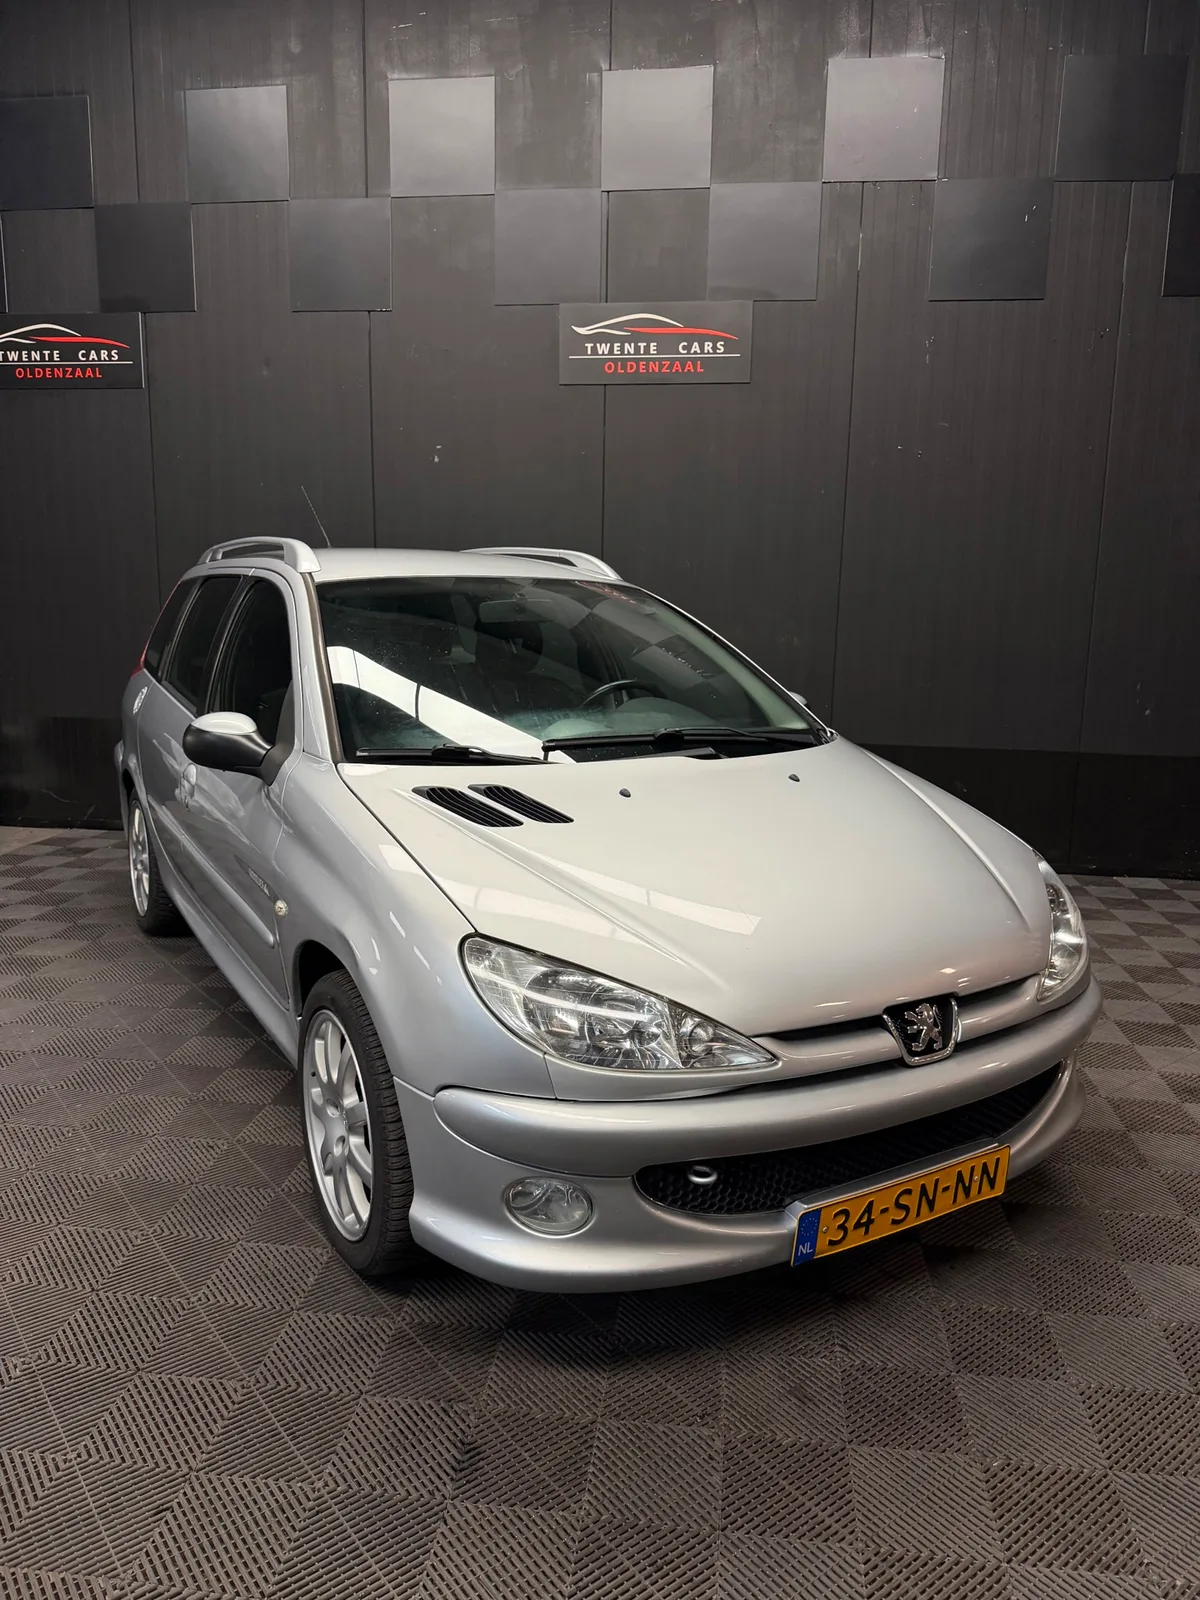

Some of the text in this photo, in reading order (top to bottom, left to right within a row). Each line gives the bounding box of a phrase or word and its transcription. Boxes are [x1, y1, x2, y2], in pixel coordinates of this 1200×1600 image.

[78, 349, 119, 361] CARS
[585, 341, 725, 355] TWENTE CARS
[15, 367, 103, 379] OLDENZAAL
[604, 360, 704, 374] OLDENZAAL
[827, 1156, 1001, 1246] 34-SN-NN
[798, 1241, 815, 1256] NL
